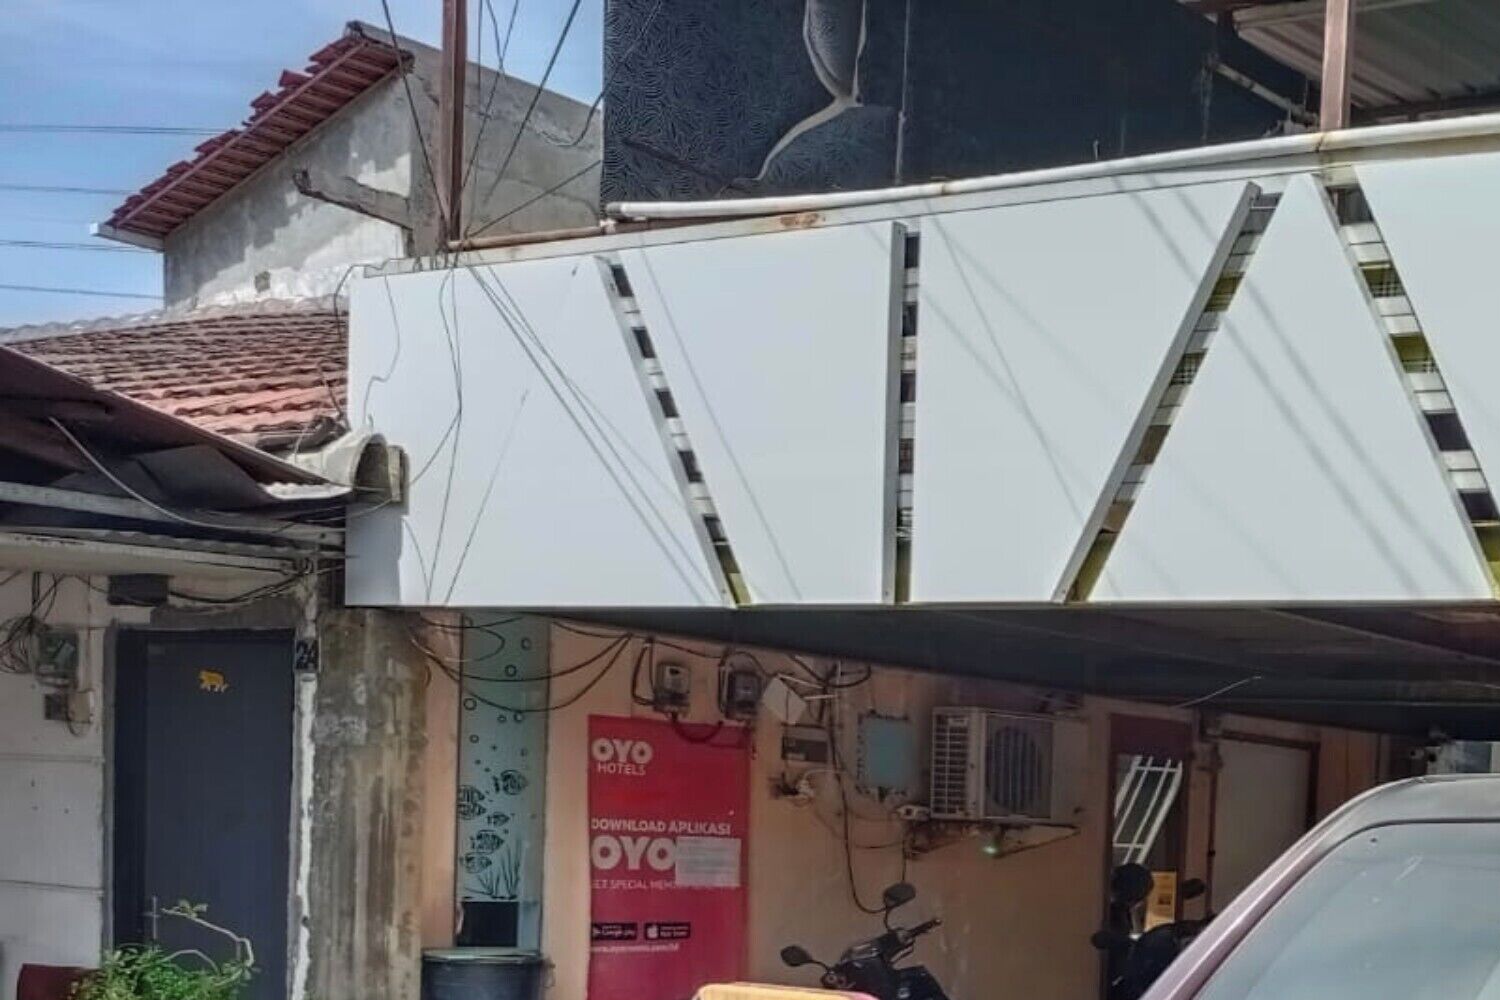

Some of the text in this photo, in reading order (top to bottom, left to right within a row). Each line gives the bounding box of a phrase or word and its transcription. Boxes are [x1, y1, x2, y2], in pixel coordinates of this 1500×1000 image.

[591, 737, 653, 764] OYO
[597, 762, 646, 776] HOTELS
[591, 818, 731, 835] DOWNLOAD APLIKASI
[591, 834, 676, 871] OYO
